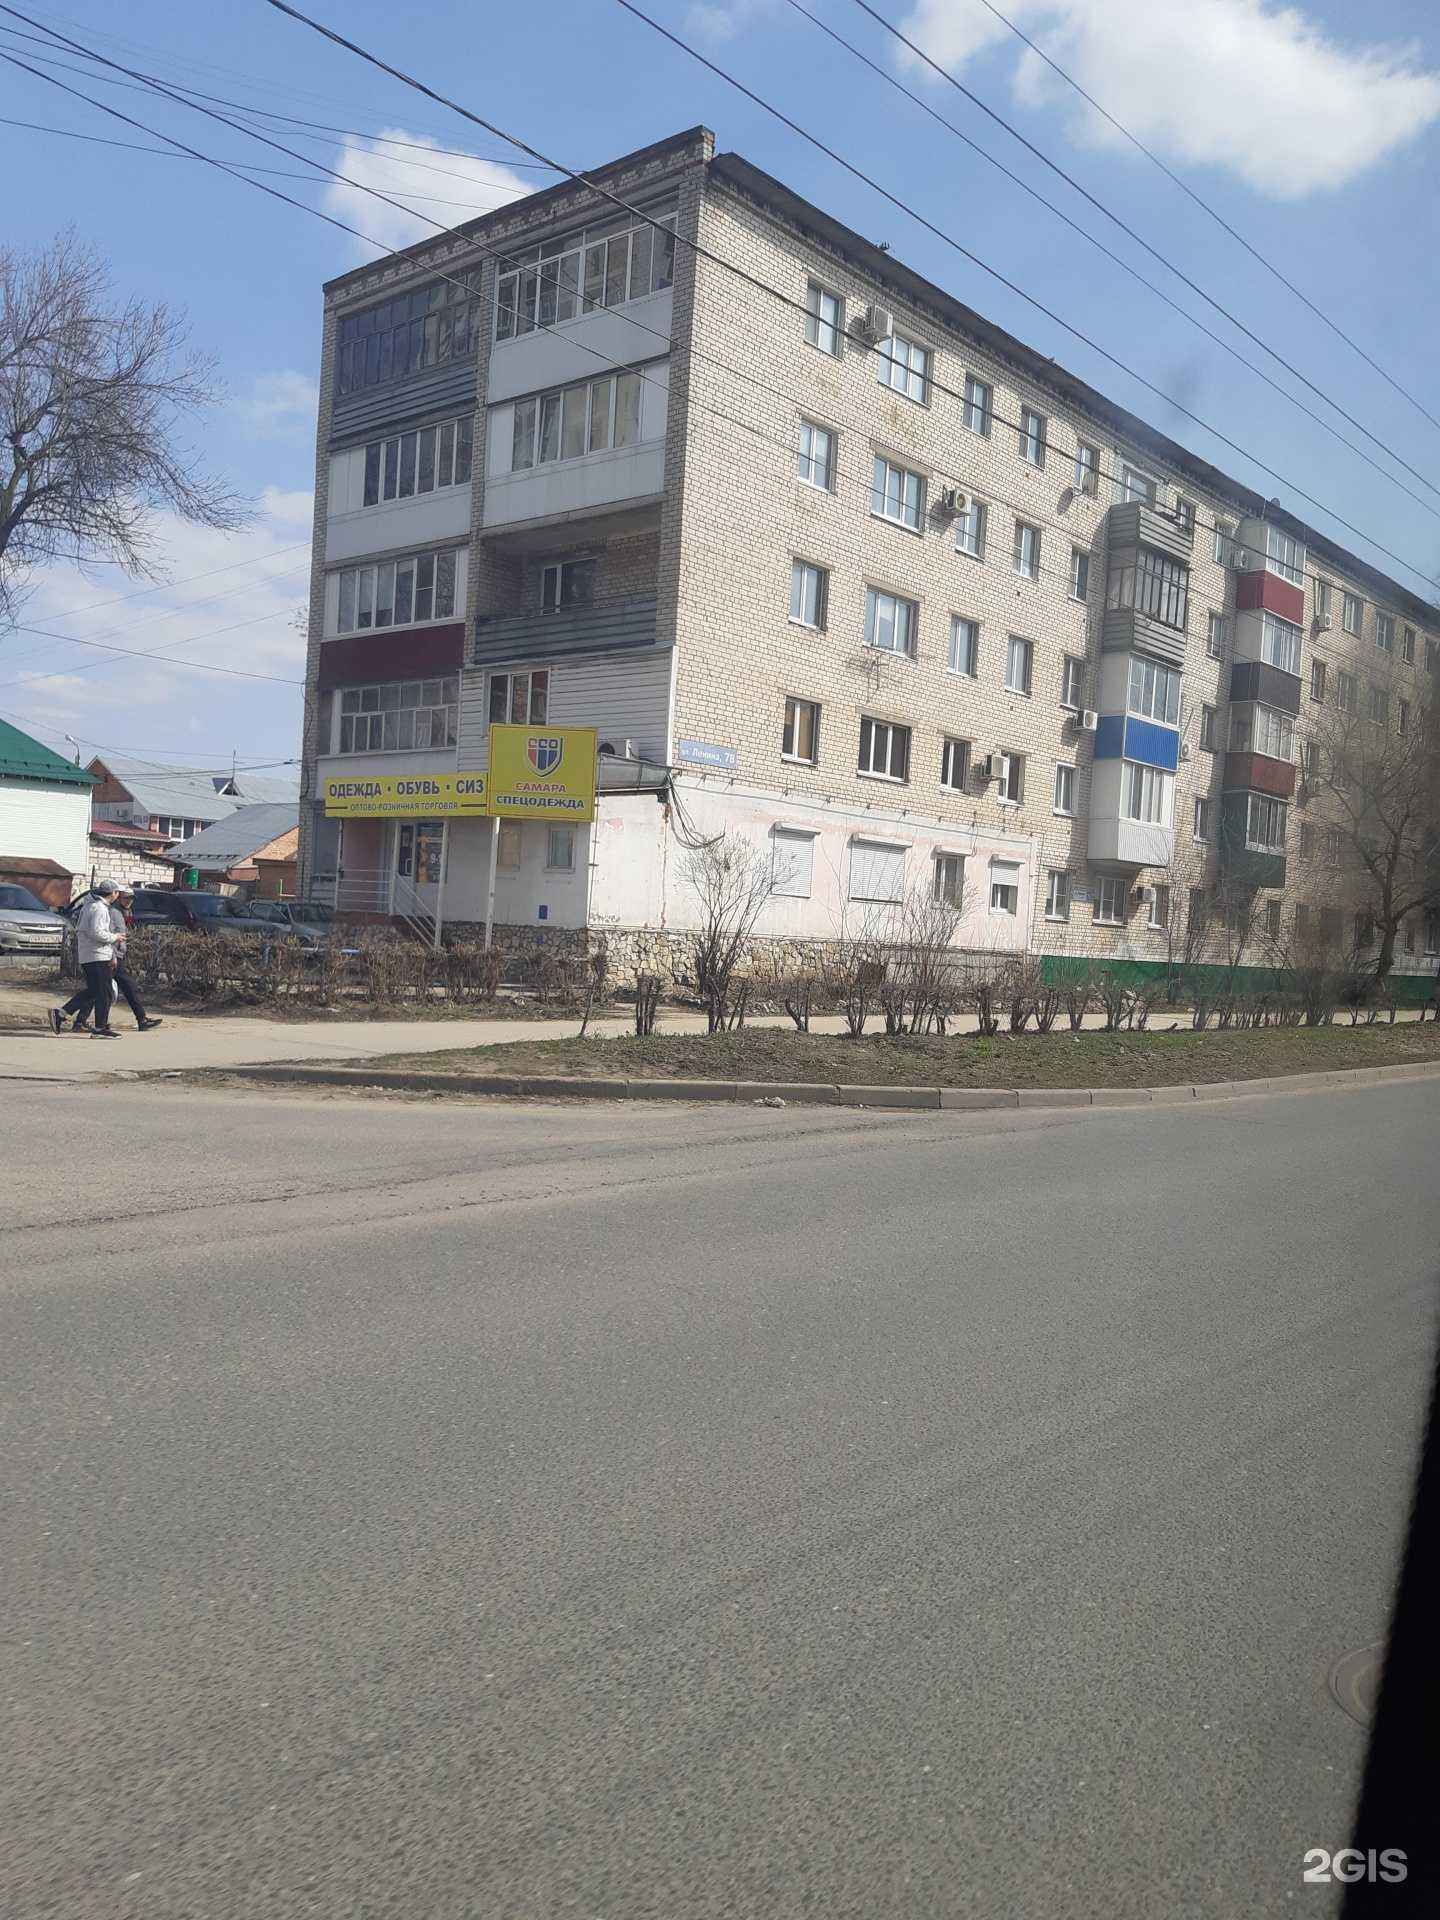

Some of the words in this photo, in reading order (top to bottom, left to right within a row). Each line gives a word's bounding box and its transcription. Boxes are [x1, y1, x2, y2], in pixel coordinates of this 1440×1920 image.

[329, 781, 382, 799] ОДЕЖДА
[396, 780, 440, 795] ОБУВЬ
[456, 779, 484, 794] СИЗ
[515, 782, 566, 793] САМАРА
[420, 802, 458, 811] ТОРГОВЛЯ
[496, 795, 585, 810] СПЕЦОДЕЖДА
